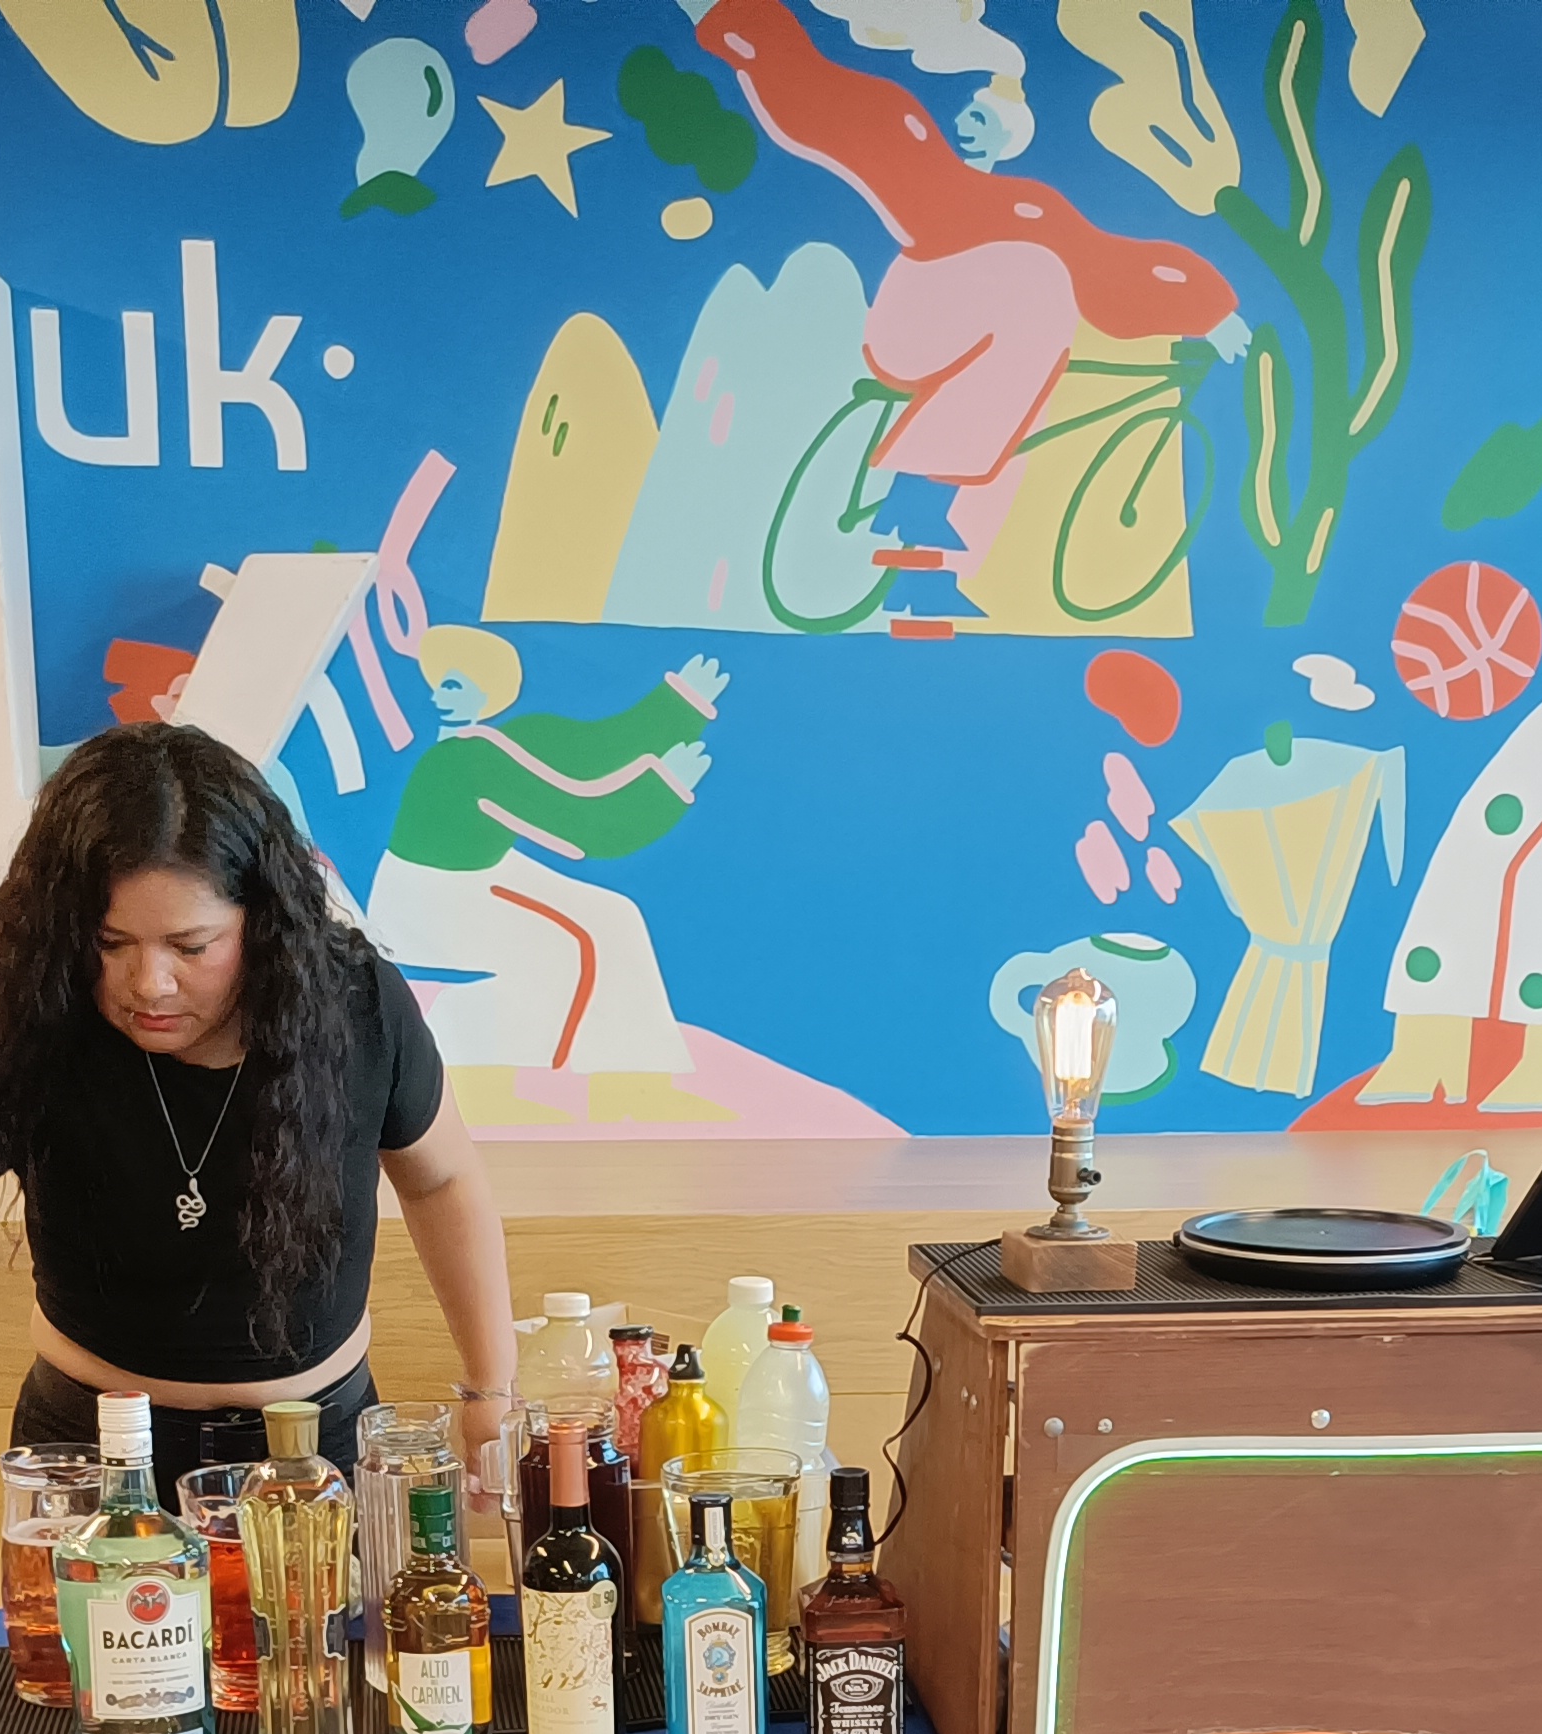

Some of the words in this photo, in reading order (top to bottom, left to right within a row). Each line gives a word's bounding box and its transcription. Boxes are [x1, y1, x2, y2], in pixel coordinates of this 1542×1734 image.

[102, 1617, 194, 1650] BACARDÍ
[697, 1621, 742, 1641] BOMBAY
[111, 1656, 146, 1665] CARTA
[150, 1651, 188, 1663] BLANCA
[420, 1659, 449, 1679] ALTO
[815, 1656, 849, 1682] JACK
[411, 1684, 463, 1705] CARMEN
[696, 1679, 746, 1698] SAPPHIRE
[831, 1718, 885, 1728] WHISKEY
